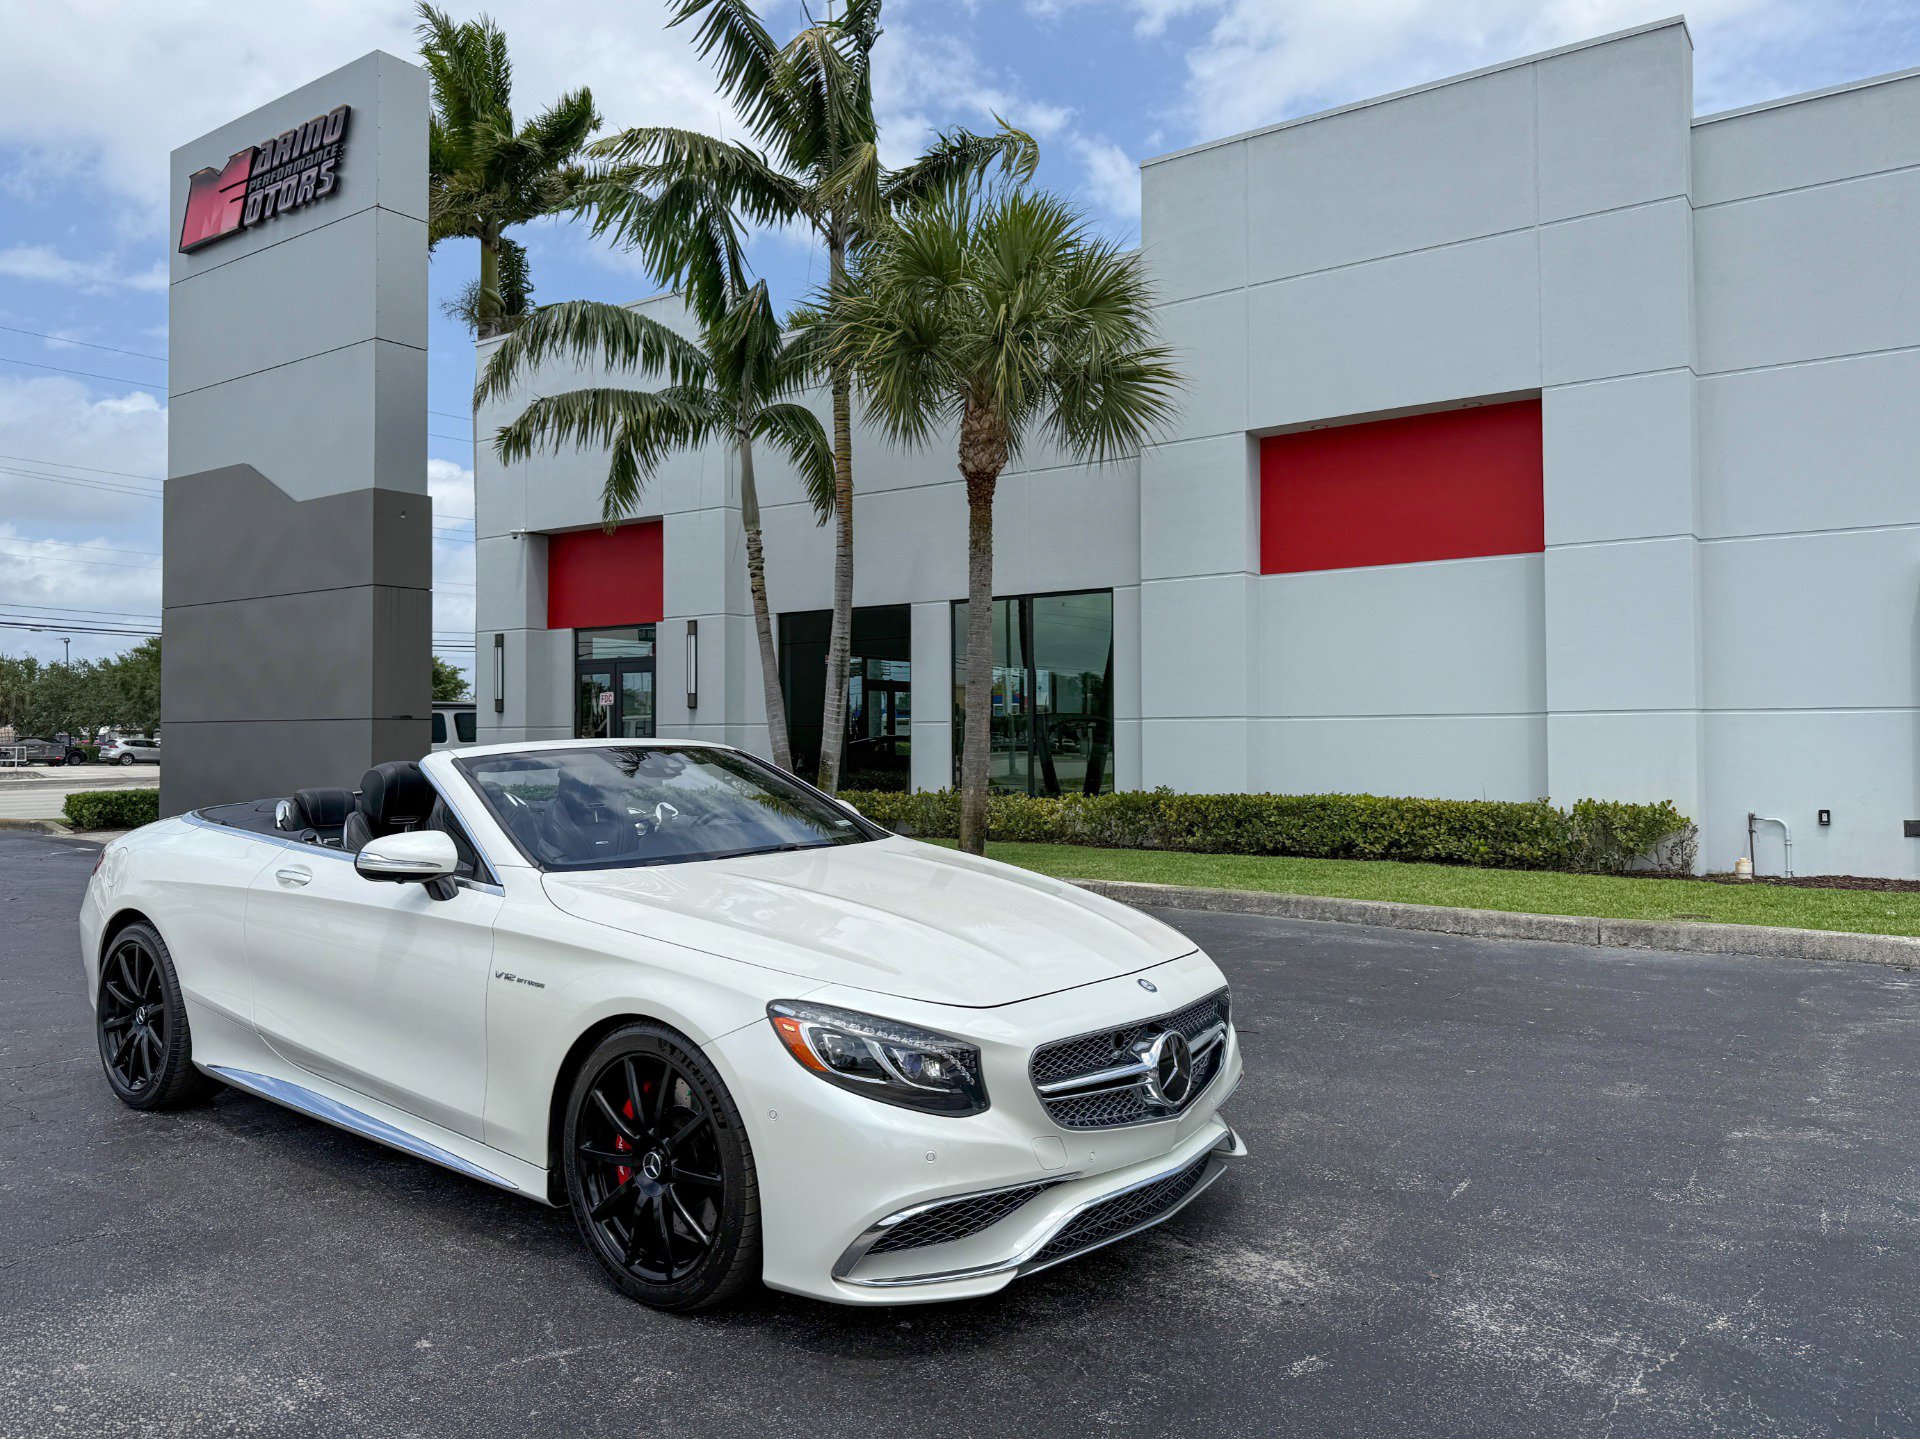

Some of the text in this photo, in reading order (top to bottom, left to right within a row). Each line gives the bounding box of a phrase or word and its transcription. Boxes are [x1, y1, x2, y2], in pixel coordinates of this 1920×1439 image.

[249, 143, 338, 192] PERFORMANCE
[495, 970, 516, 982] V12
[670, 1044, 728, 1130] MICHELIN
